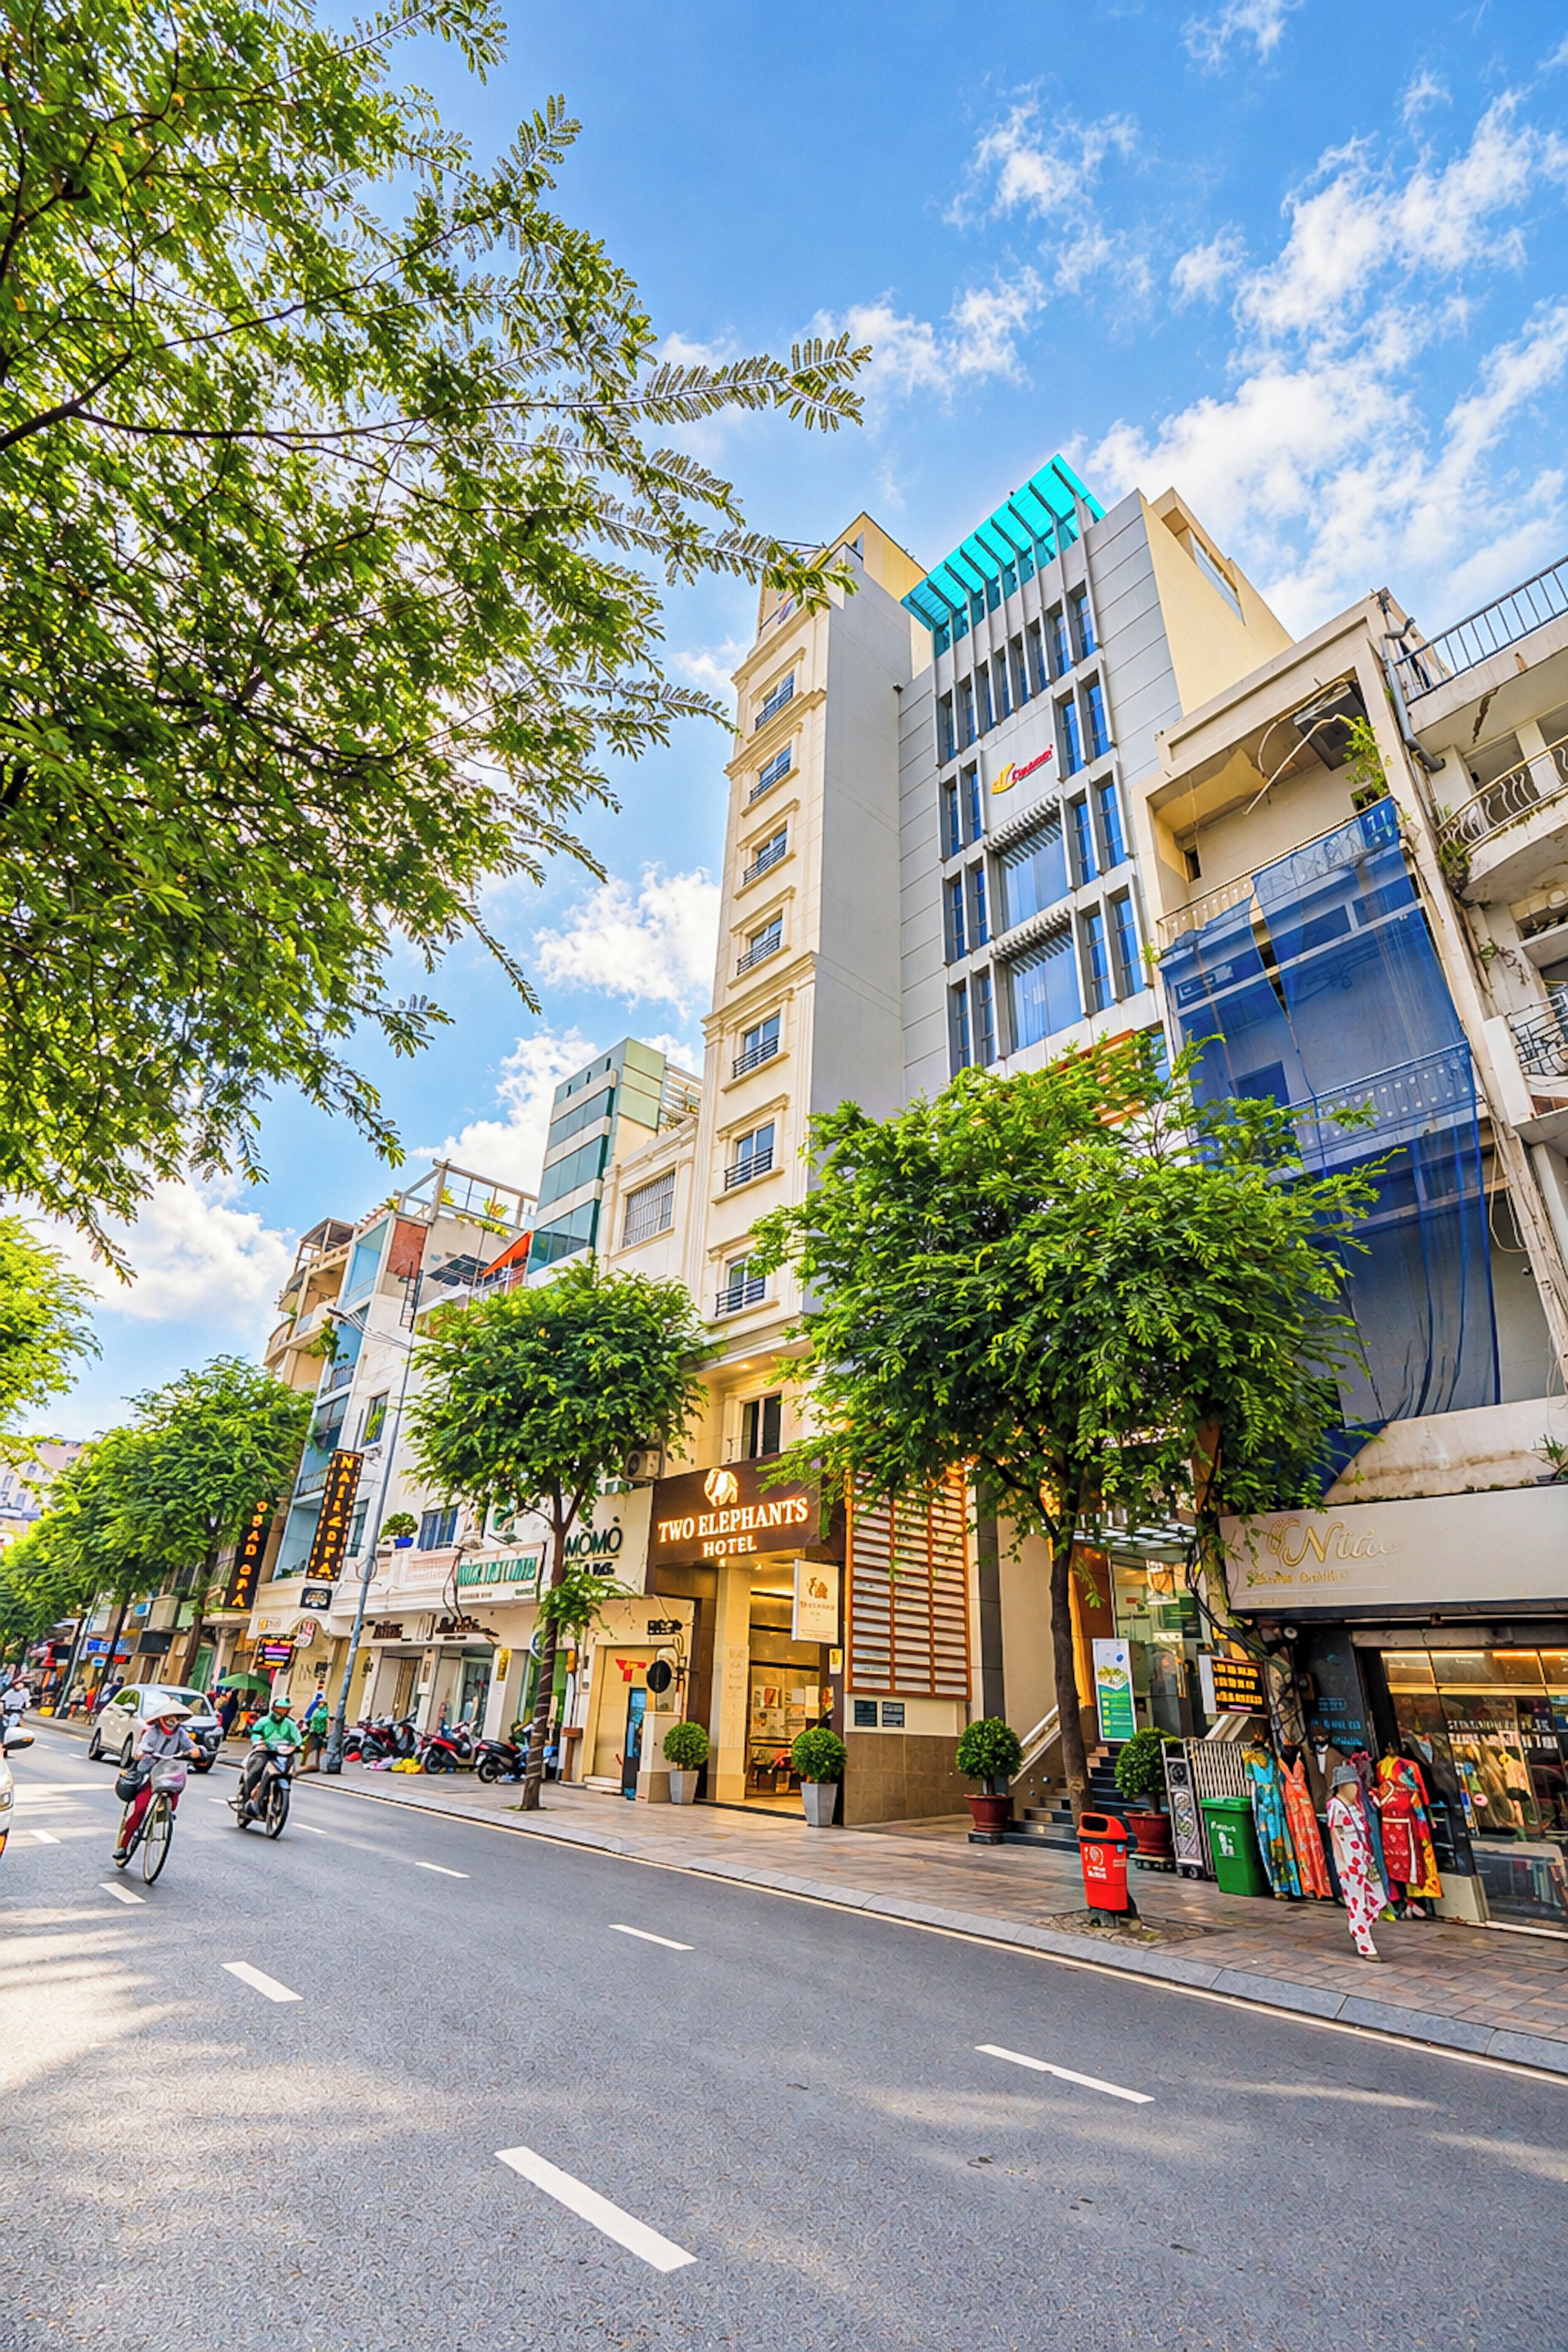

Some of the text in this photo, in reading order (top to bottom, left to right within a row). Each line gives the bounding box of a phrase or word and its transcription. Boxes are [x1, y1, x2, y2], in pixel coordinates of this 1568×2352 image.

[658, 1497, 809, 1543] TWO ELEPHANTS
[703, 1535, 758, 1558] HOTEL
